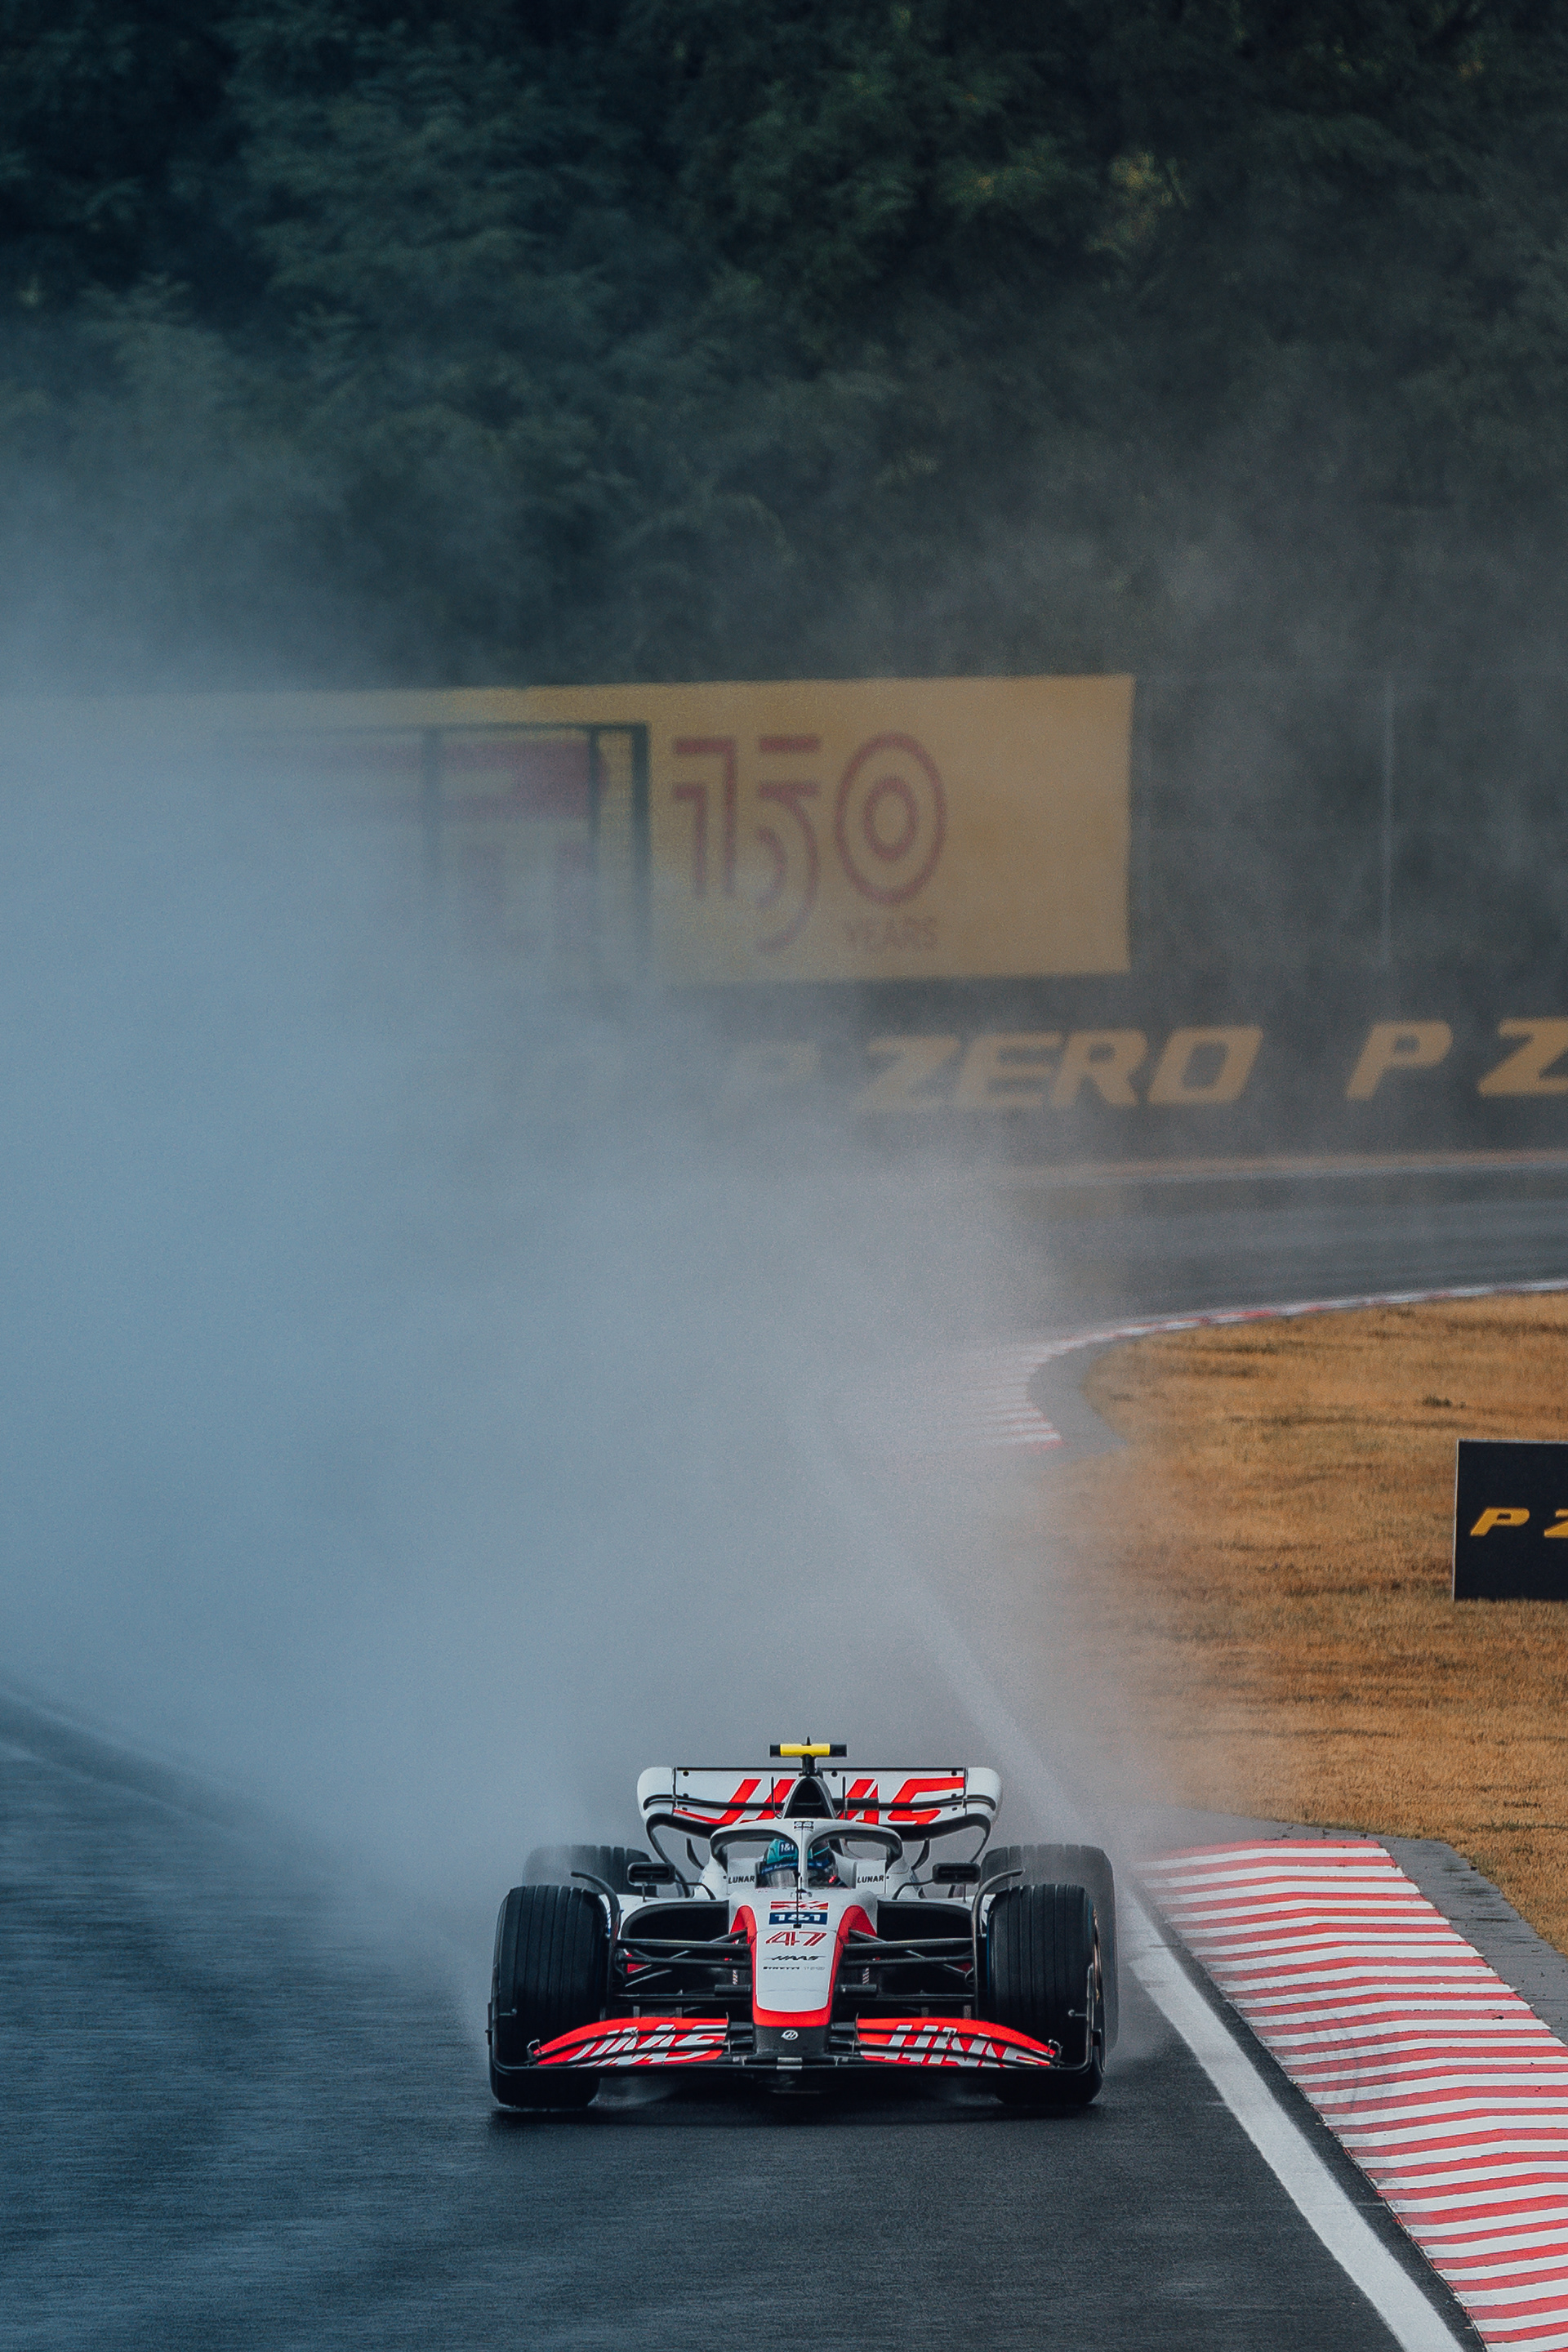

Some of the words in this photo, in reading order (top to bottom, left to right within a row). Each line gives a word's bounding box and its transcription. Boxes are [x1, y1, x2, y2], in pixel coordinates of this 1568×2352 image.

[672, 732, 947, 956] 150
[844, 915, 938, 951] YEARS
[853, 1026, 1264, 1112] ZERO
[1345, 1020, 1454, 1101] P
[1471, 1508, 1530, 1536] P
[674, 1779, 964, 1824] HAS
[728, 1875, 755, 1884] LUNAR
[858, 1875, 884, 1883] LUNAR
[765, 1931, 827, 1946] 47
